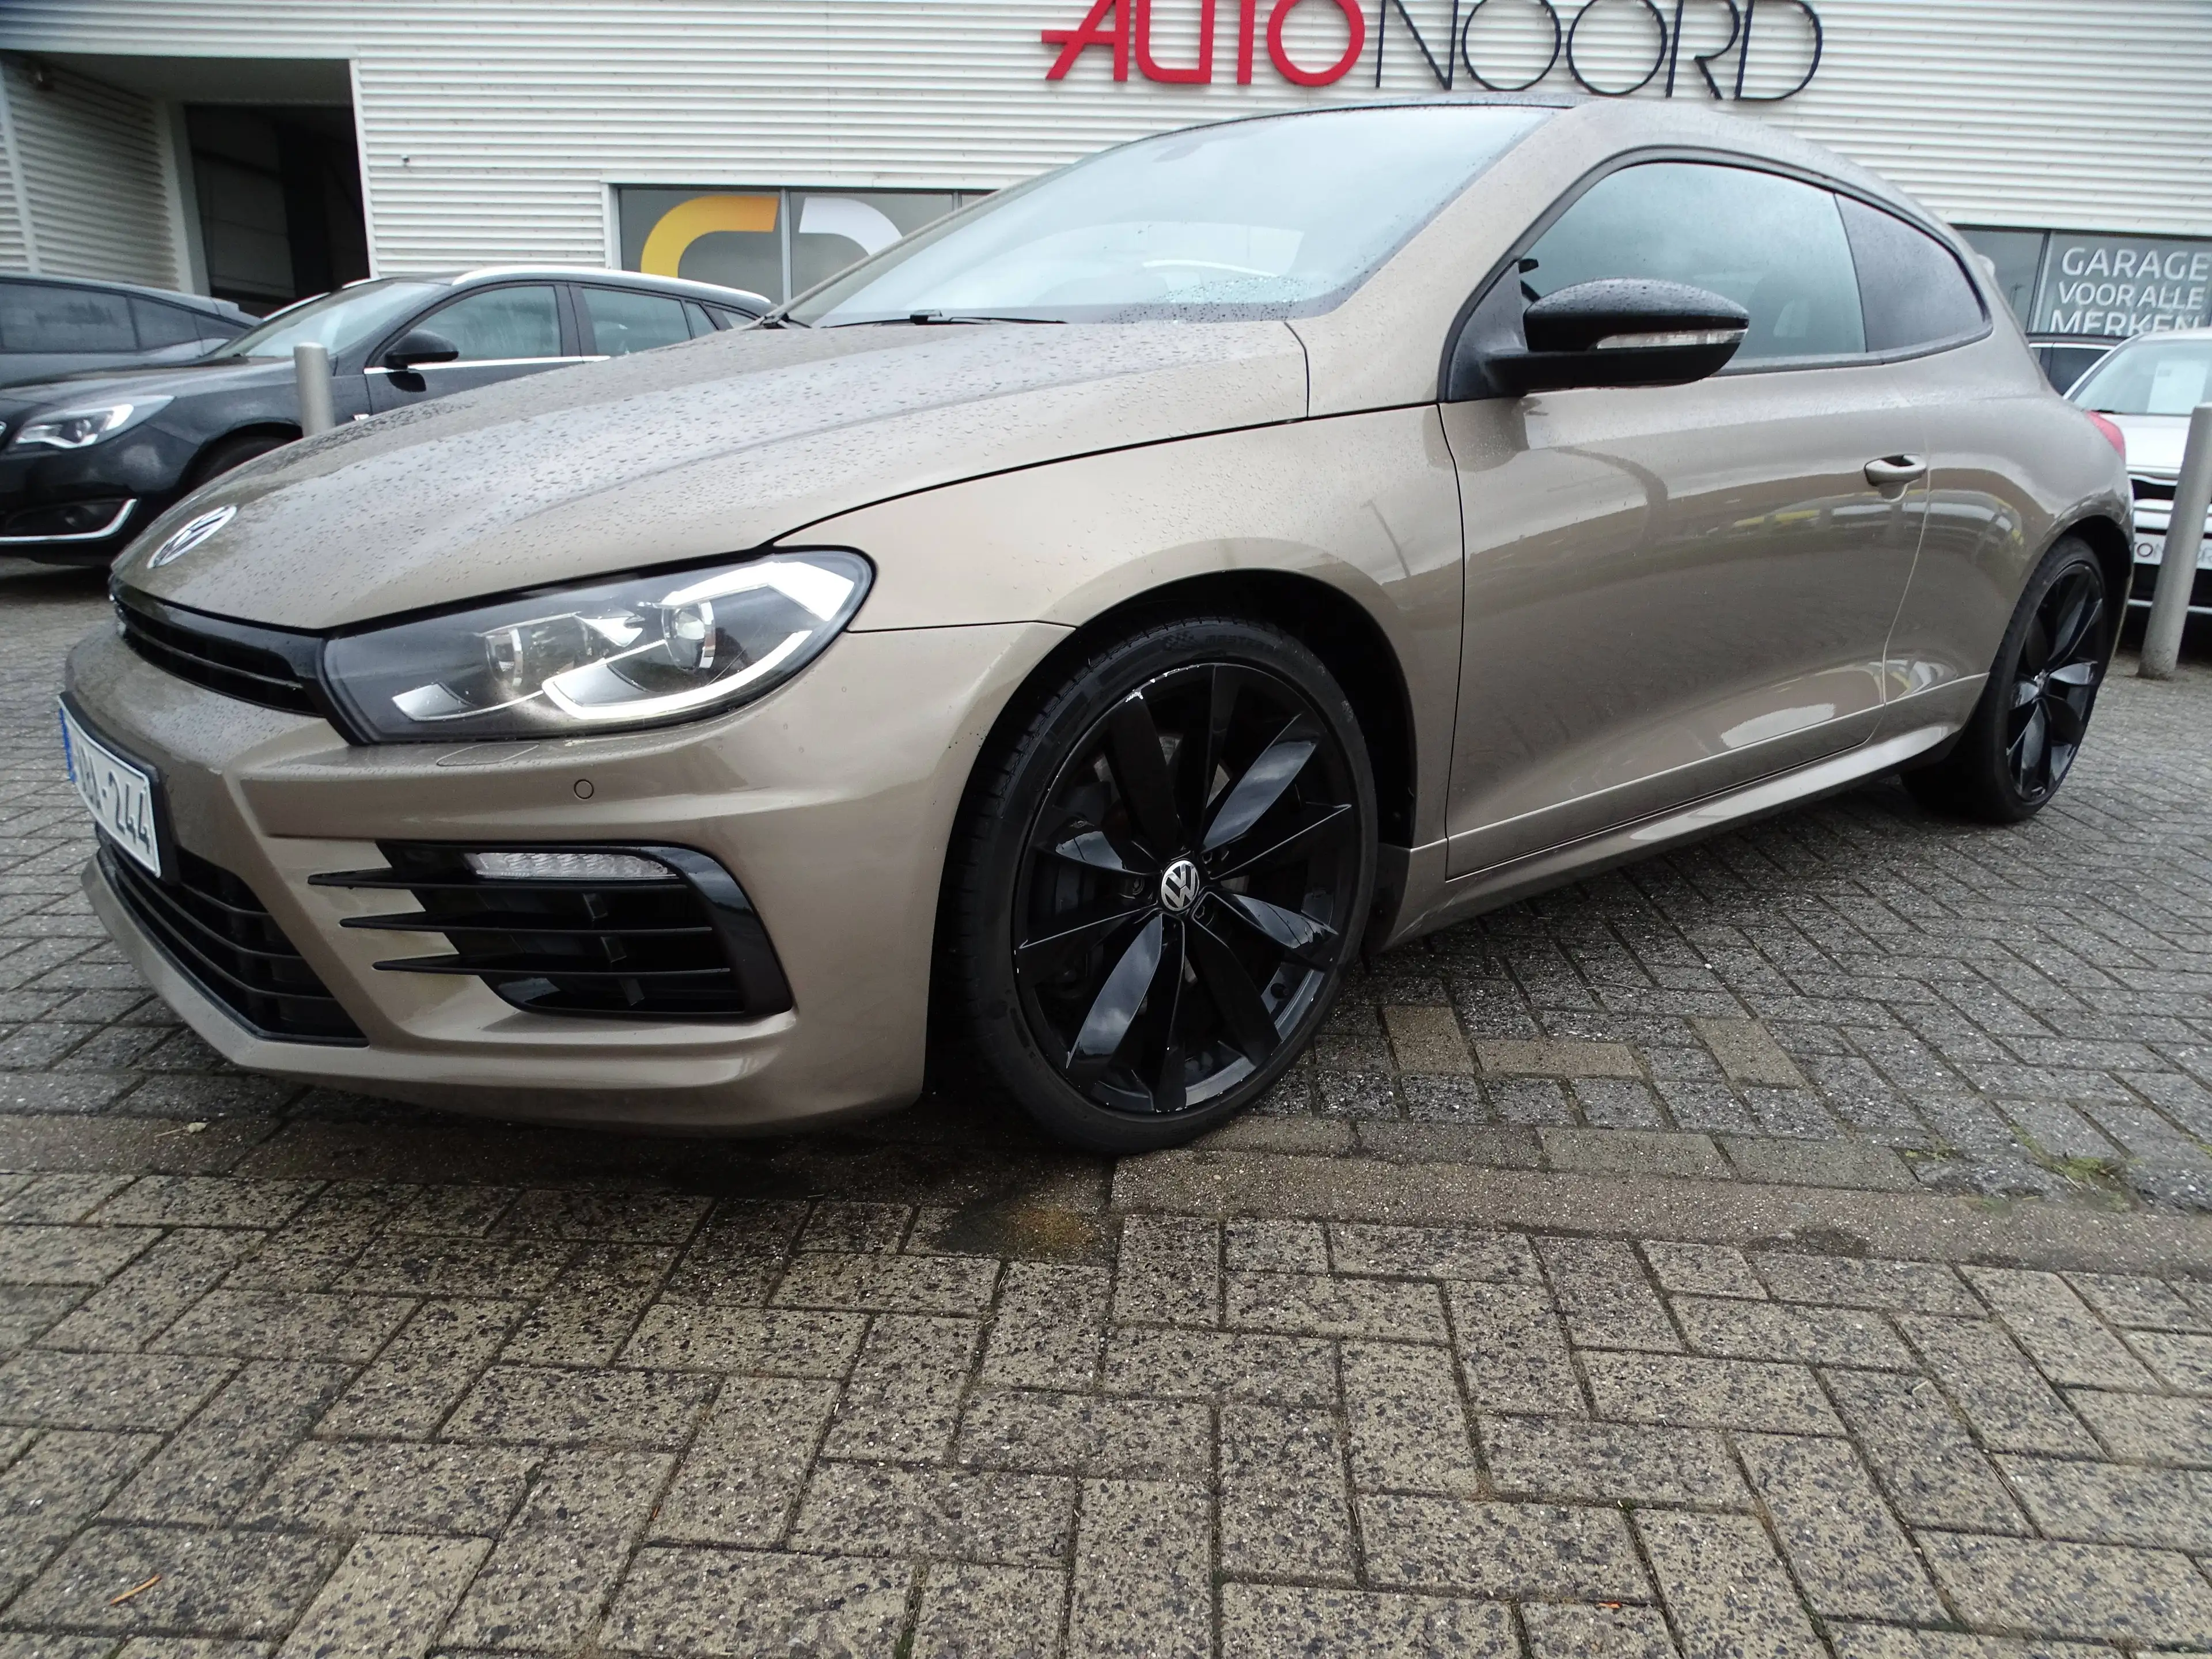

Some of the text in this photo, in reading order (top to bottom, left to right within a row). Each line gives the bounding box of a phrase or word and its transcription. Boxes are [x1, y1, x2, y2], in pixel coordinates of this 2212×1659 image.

[2061, 247, 2212, 282] GARAGE
[2058, 281, 2207, 310] VOOR ALLE
